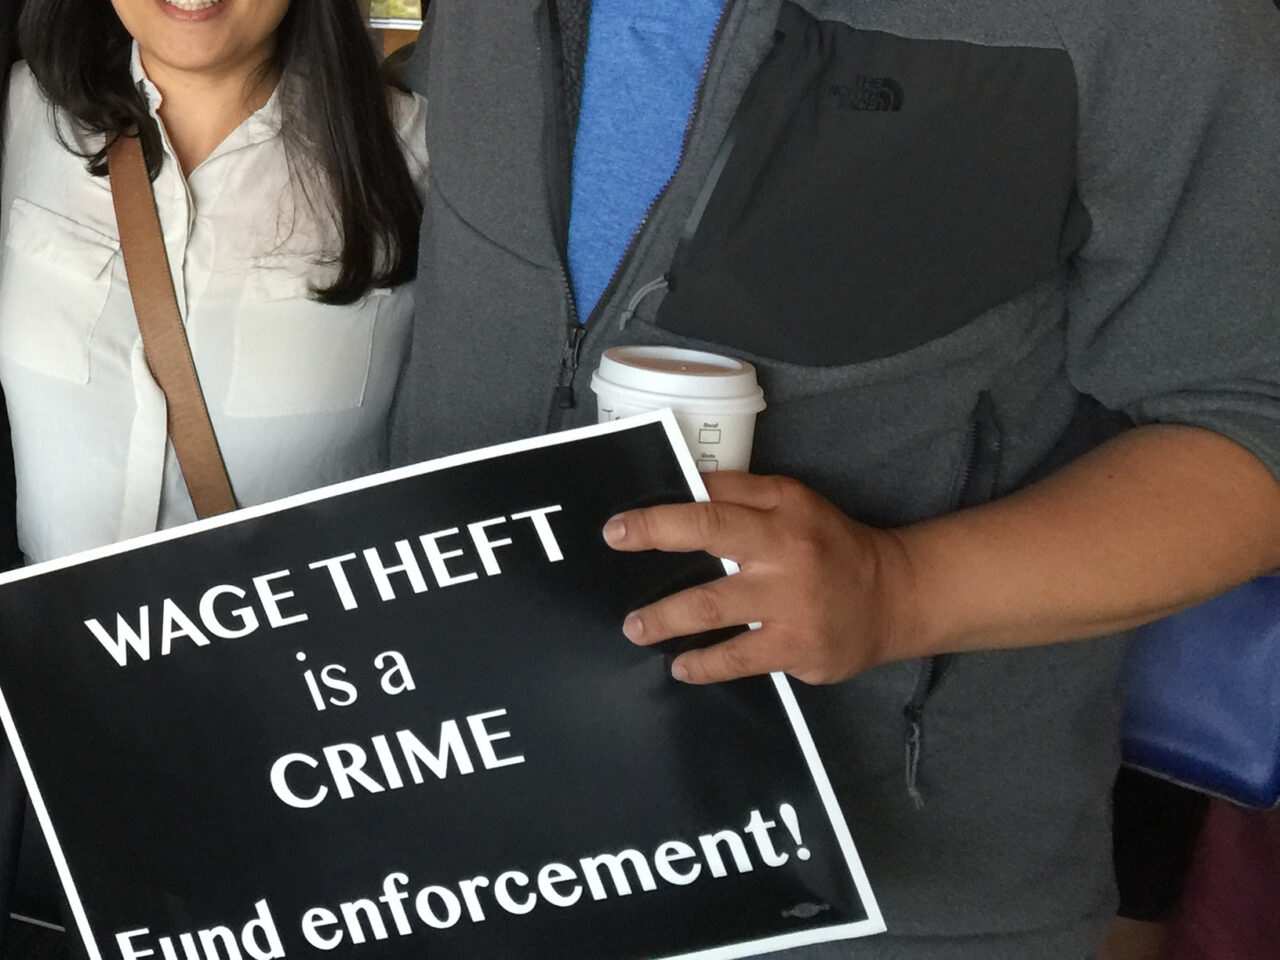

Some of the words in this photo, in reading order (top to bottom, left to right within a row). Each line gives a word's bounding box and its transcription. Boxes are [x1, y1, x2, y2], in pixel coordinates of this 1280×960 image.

[84, 569, 309, 667] WAGE
[308, 504, 565, 612] THEFT
[296, 651, 358, 711] is
[374, 651, 416, 695] a
[269, 708, 526, 809] CRIME
[115, 898, 286, 960] Fund
[302, 803, 811, 951] enforcement!
